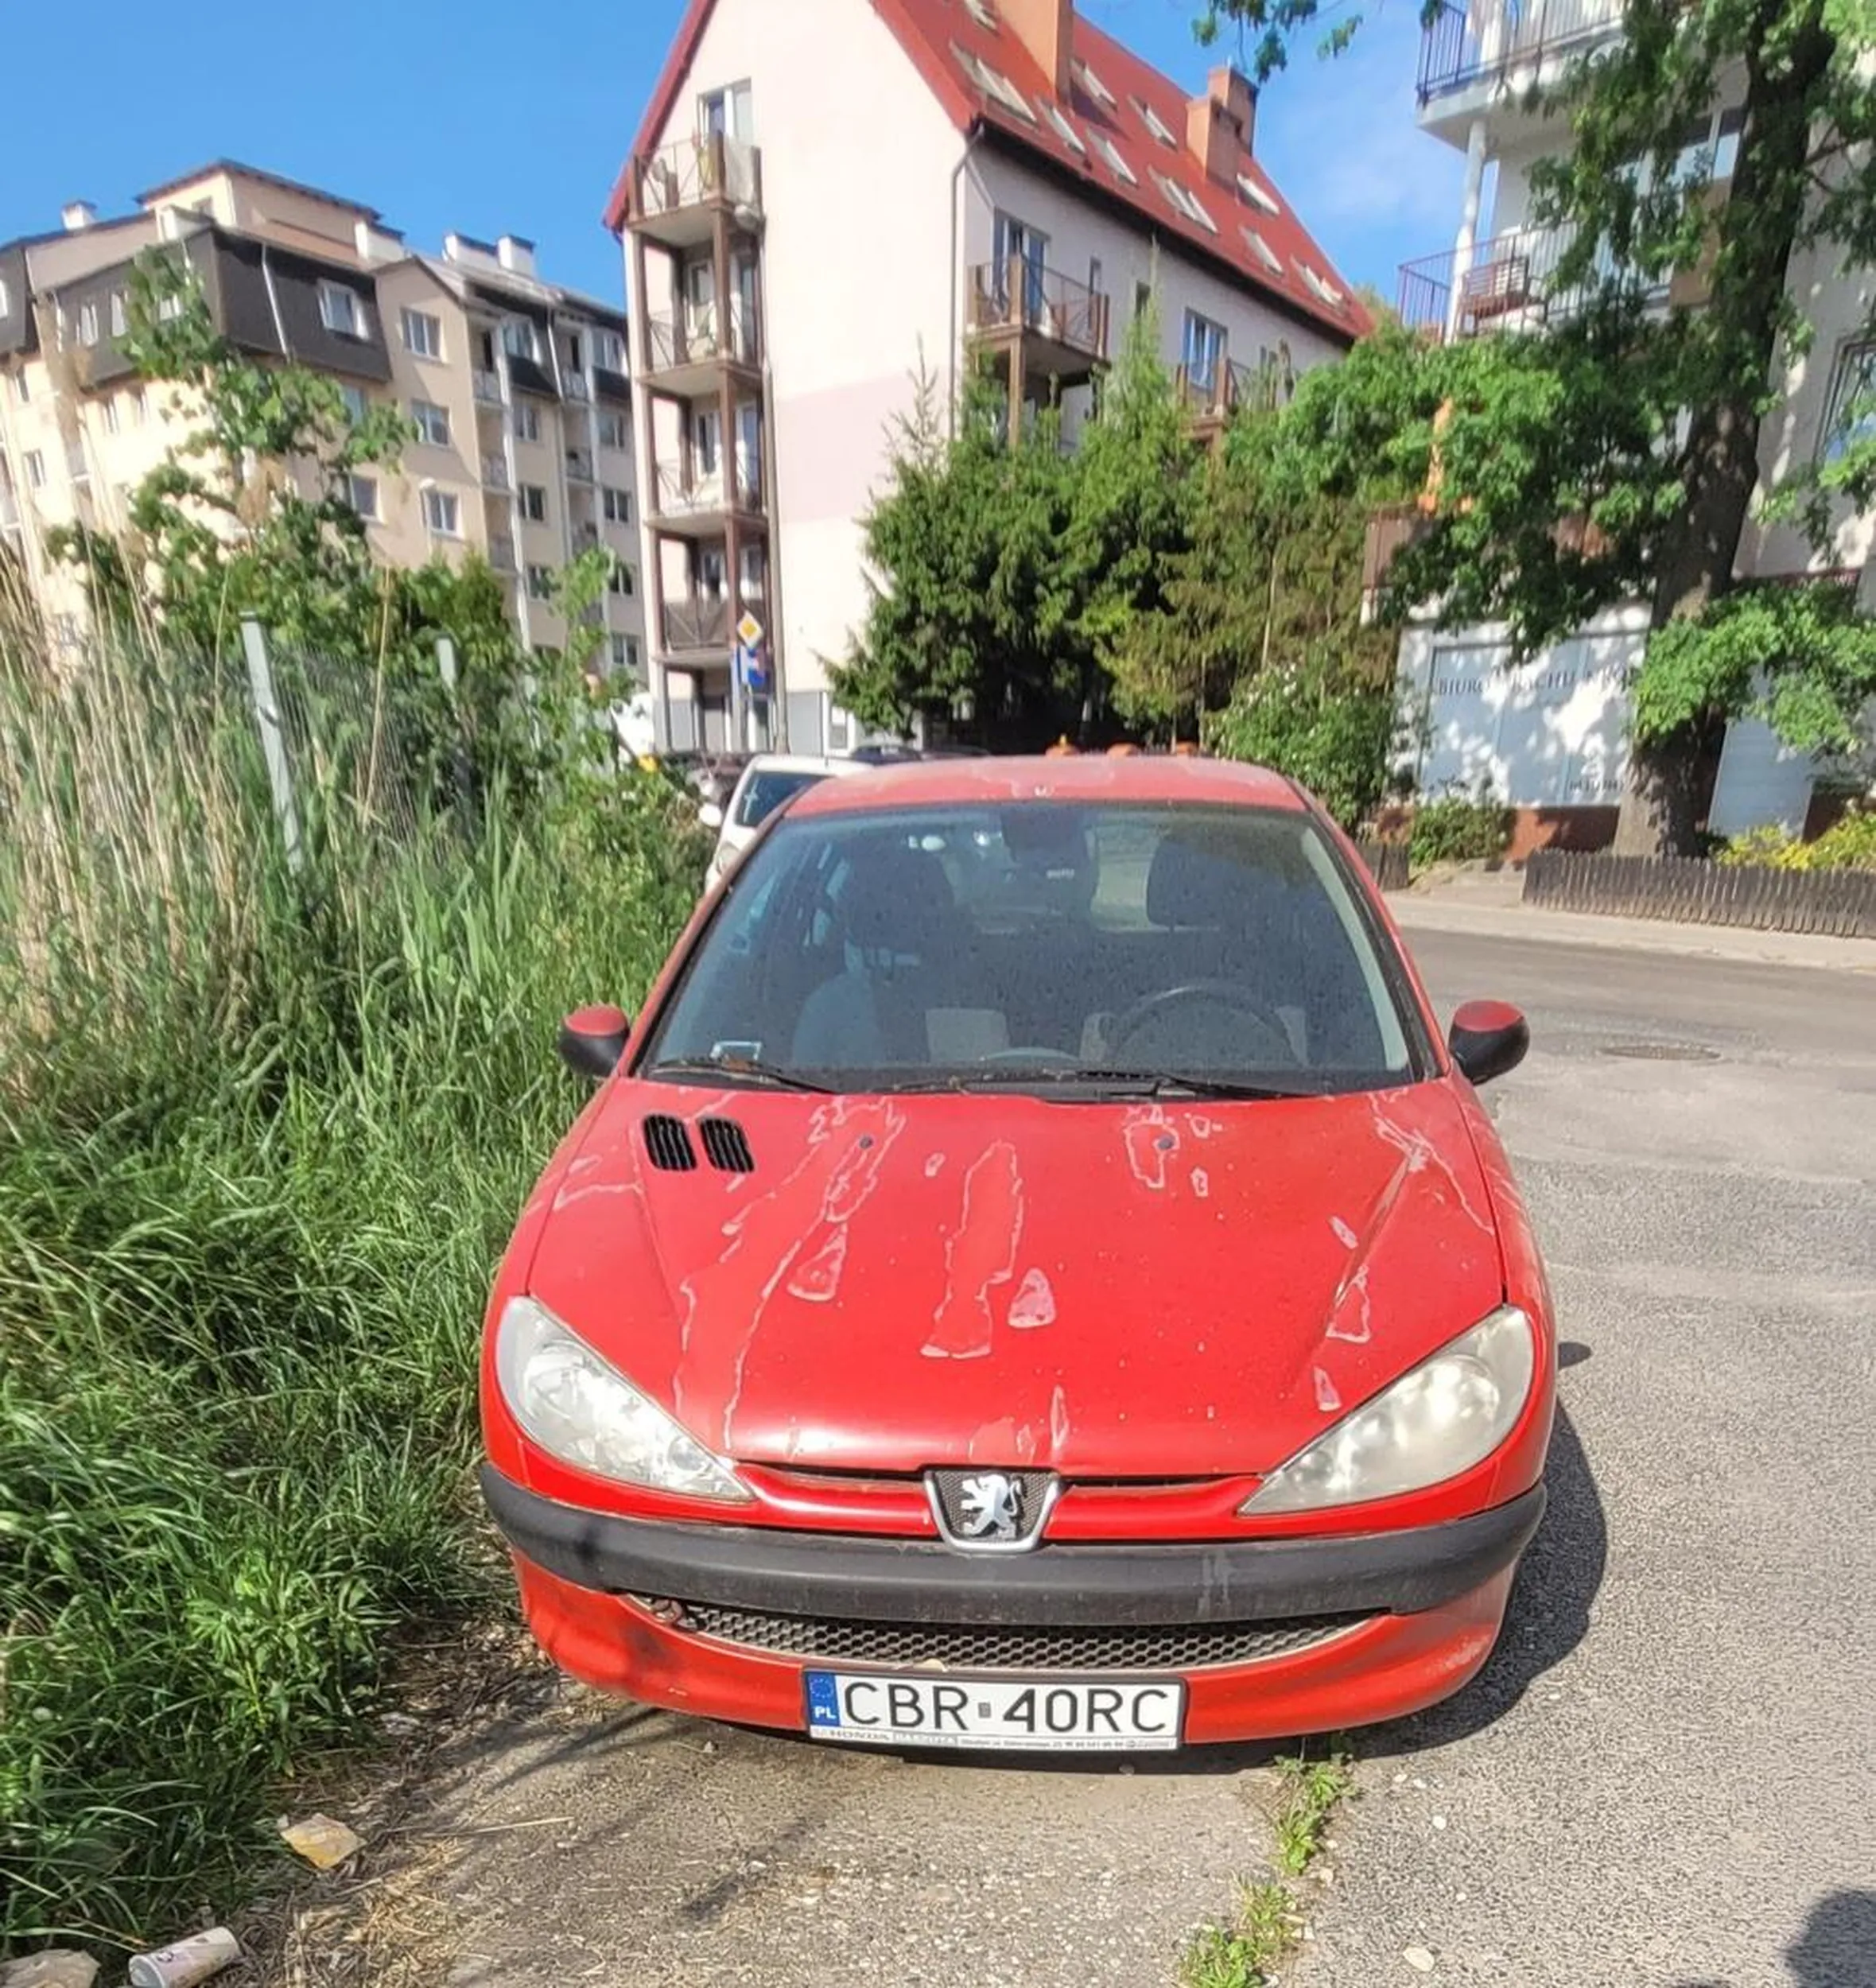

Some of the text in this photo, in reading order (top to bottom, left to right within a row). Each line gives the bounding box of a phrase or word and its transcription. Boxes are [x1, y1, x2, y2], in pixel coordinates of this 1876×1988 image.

[814, 1706, 836, 1719] PL
[845, 1681, 1168, 1733] CBR 40RC
